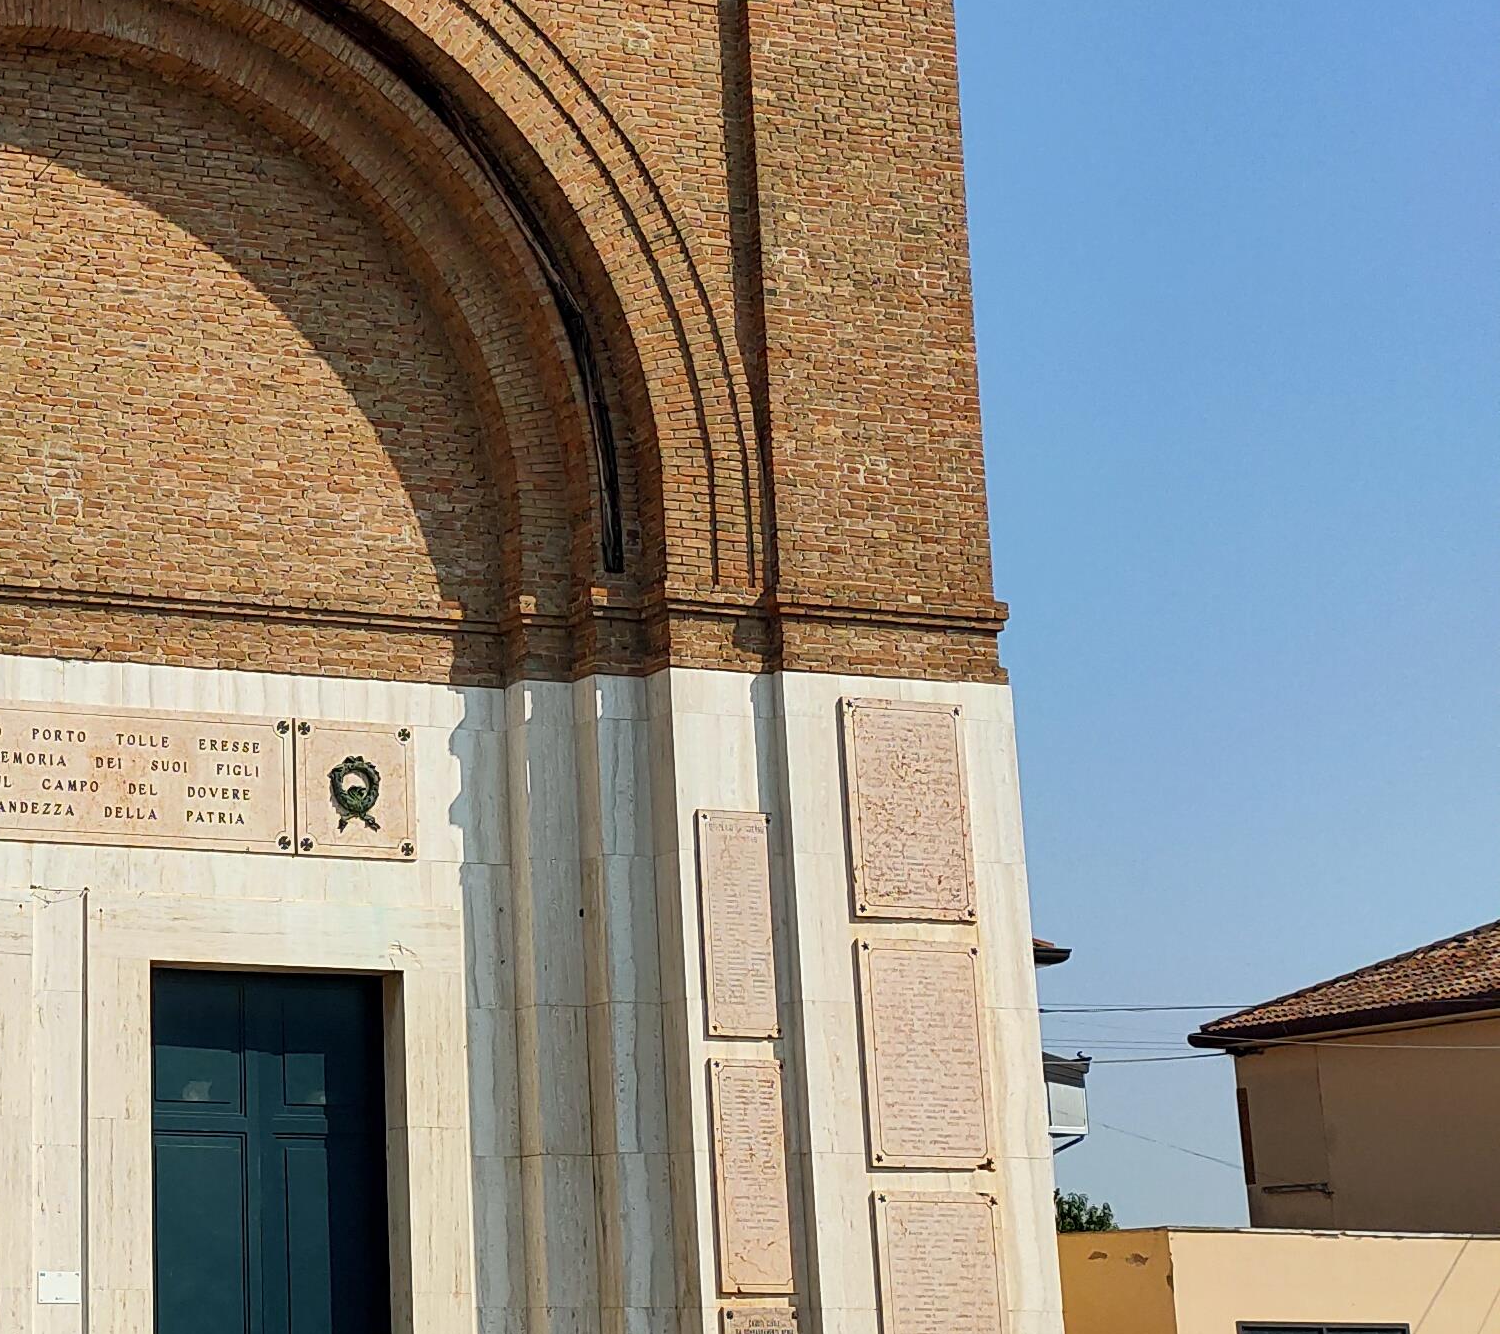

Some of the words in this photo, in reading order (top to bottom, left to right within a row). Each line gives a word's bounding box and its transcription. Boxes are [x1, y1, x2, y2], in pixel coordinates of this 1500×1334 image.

[32, 728, 86, 742] PORTO
[115, 733, 170, 748] TOLLE
[198, 738, 260, 754] ERESSE
[95, 756, 122, 769] DEI
[150, 759, 188, 773] SUOI
[216, 763, 260, 778] FIGLI
[41, 778, 99, 792] CAMPO
[128, 782, 158, 796] DEL
[187, 786, 250, 801] DOVERE
[104, 806, 158, 821] DELLA
[186, 810, 245, 825] PATRIA
